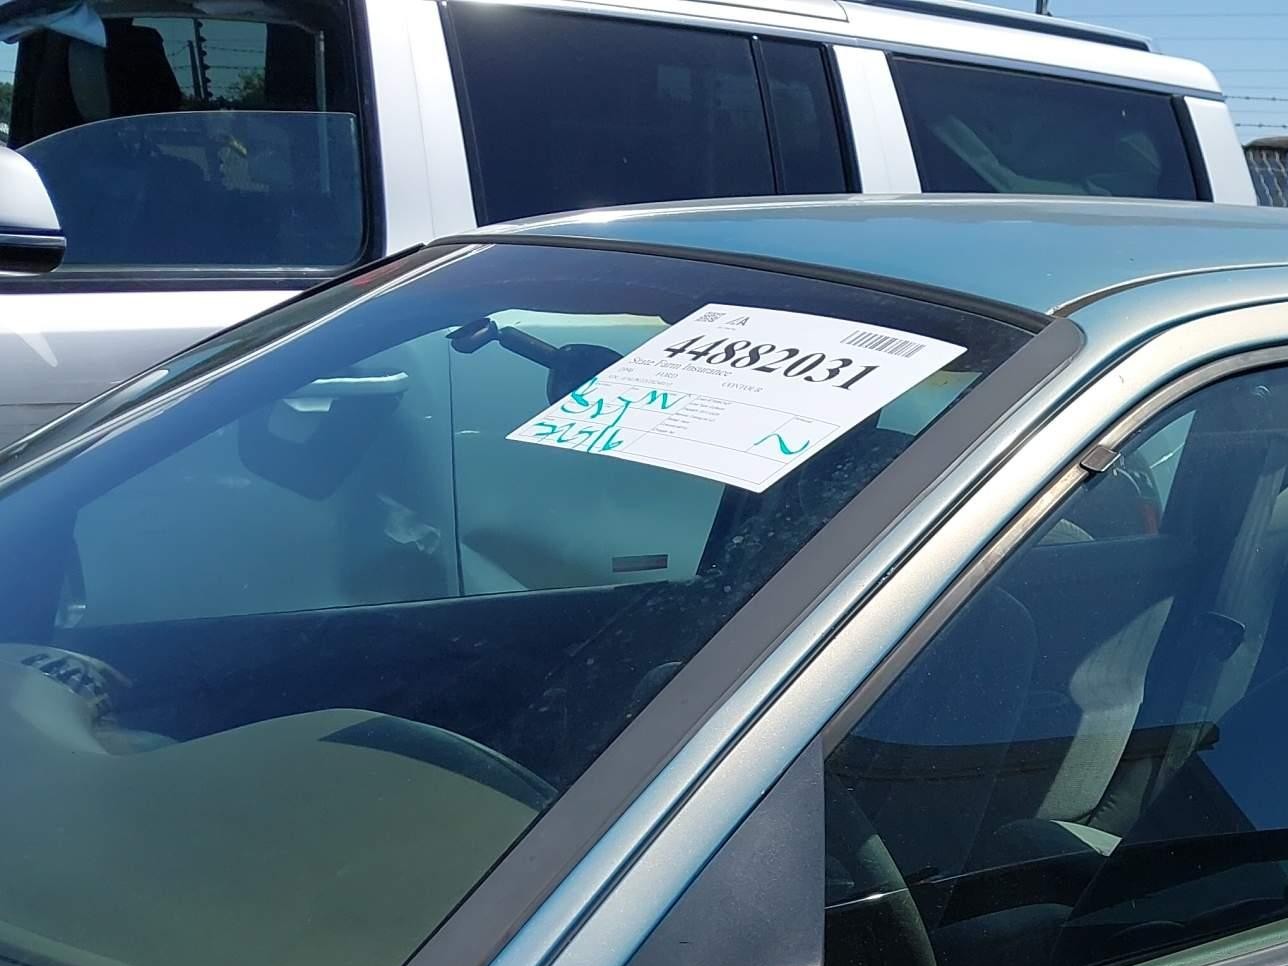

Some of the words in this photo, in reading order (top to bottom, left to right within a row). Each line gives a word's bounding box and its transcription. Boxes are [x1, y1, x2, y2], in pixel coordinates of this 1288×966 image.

[629, 356, 655, 366] State
[655, 360, 682, 370] Farm
[683, 363, 733, 377] Insurance
[664, 335, 880, 391] 44882031
